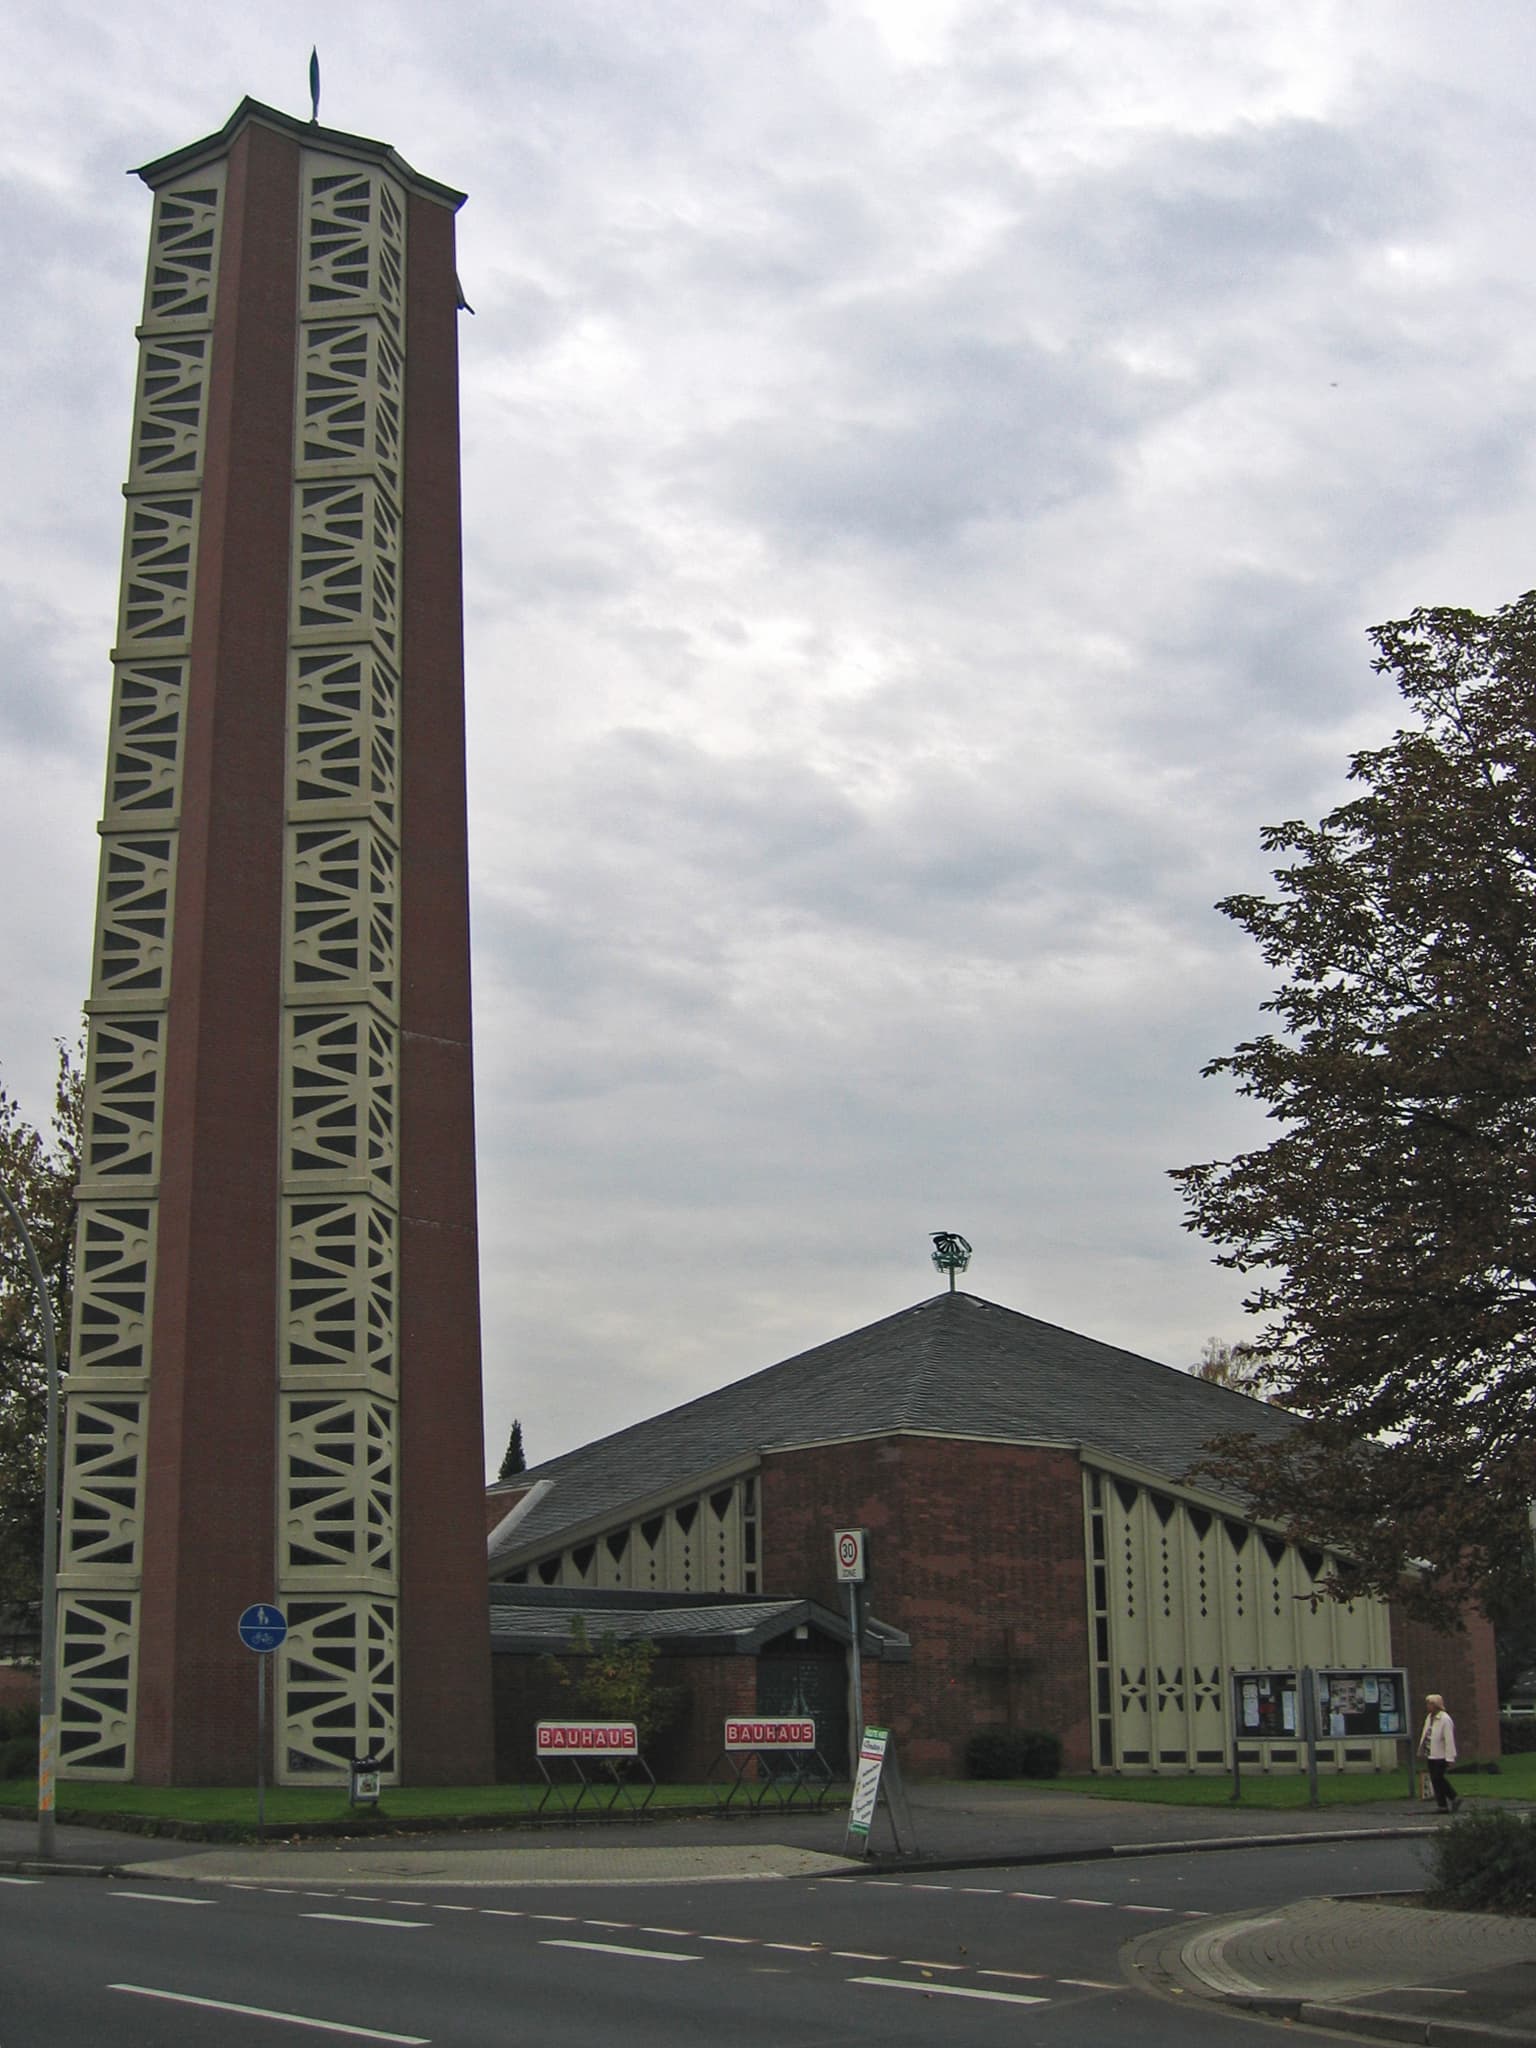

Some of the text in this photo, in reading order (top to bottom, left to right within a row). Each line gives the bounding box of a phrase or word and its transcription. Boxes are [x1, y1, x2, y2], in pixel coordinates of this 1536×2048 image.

[842, 1543, 854, 1558] 30
[540, 1730, 634, 1745] BAUHAUS
[728, 1726, 812, 1740] BAUHAUS
